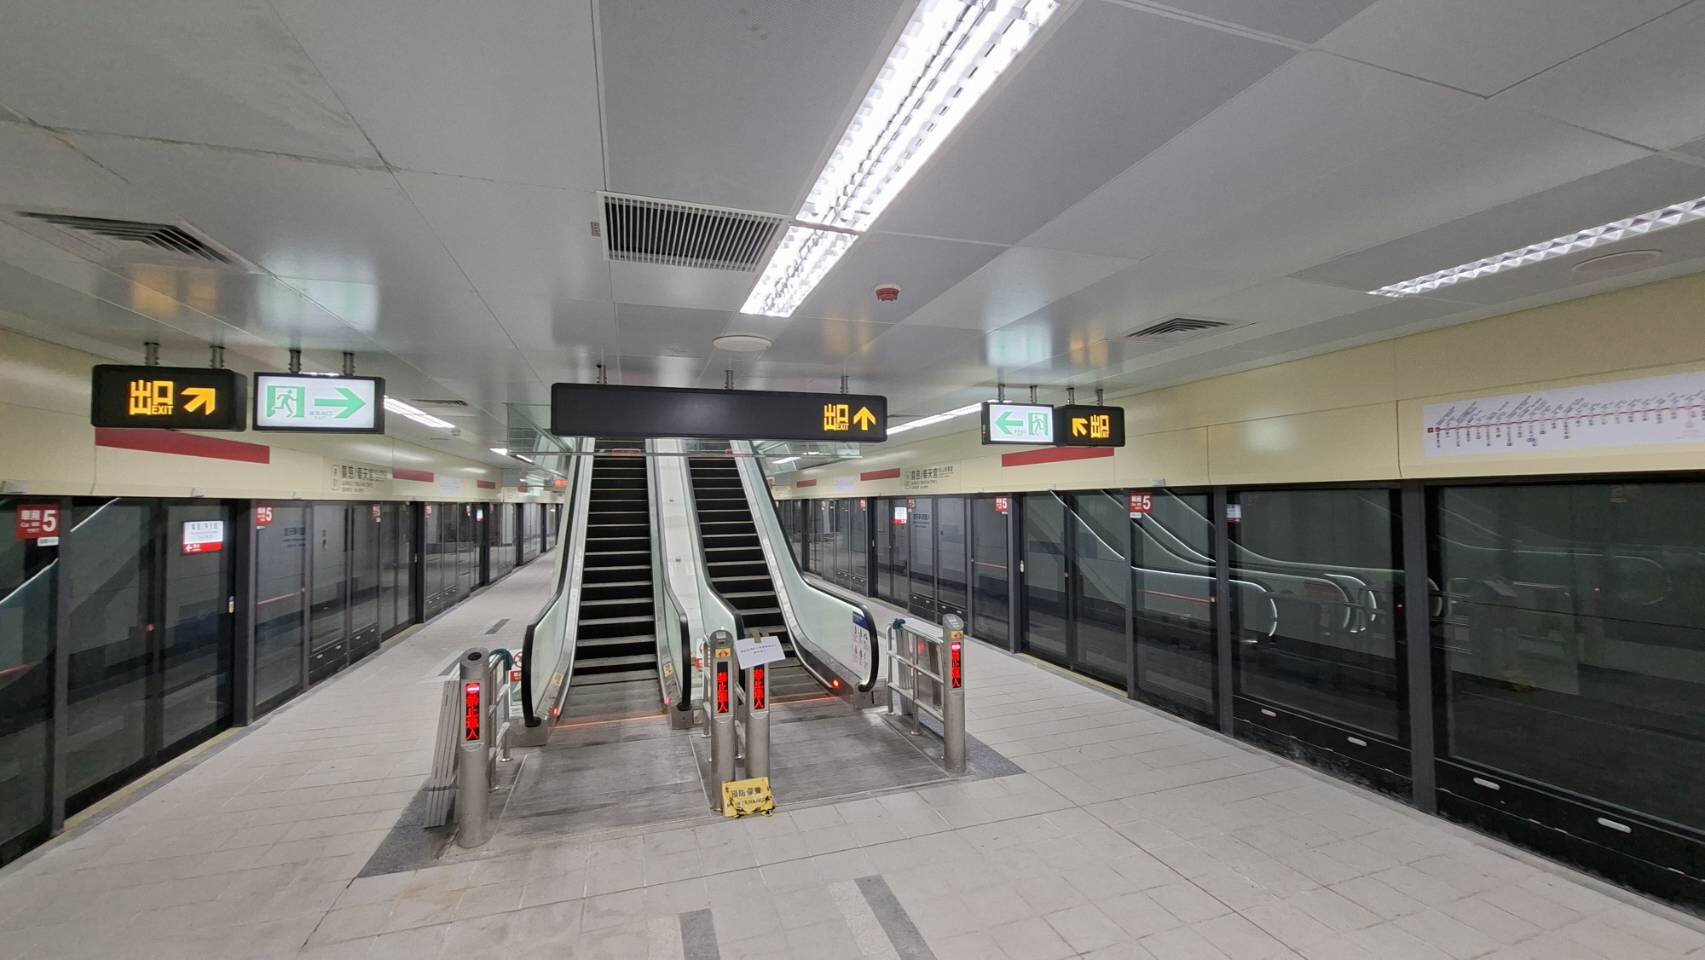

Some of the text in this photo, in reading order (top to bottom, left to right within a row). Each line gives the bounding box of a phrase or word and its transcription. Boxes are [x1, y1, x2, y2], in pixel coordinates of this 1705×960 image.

[129, 379, 174, 415] 出口
[151, 405, 174, 415] EXIT
[824, 403, 849, 431] 出口
[1091, 415, 1109, 438] 出口
[266, 507, 273, 521] 5
[1142, 495, 1151, 510] 5
[42, 509, 57, 532] 5
